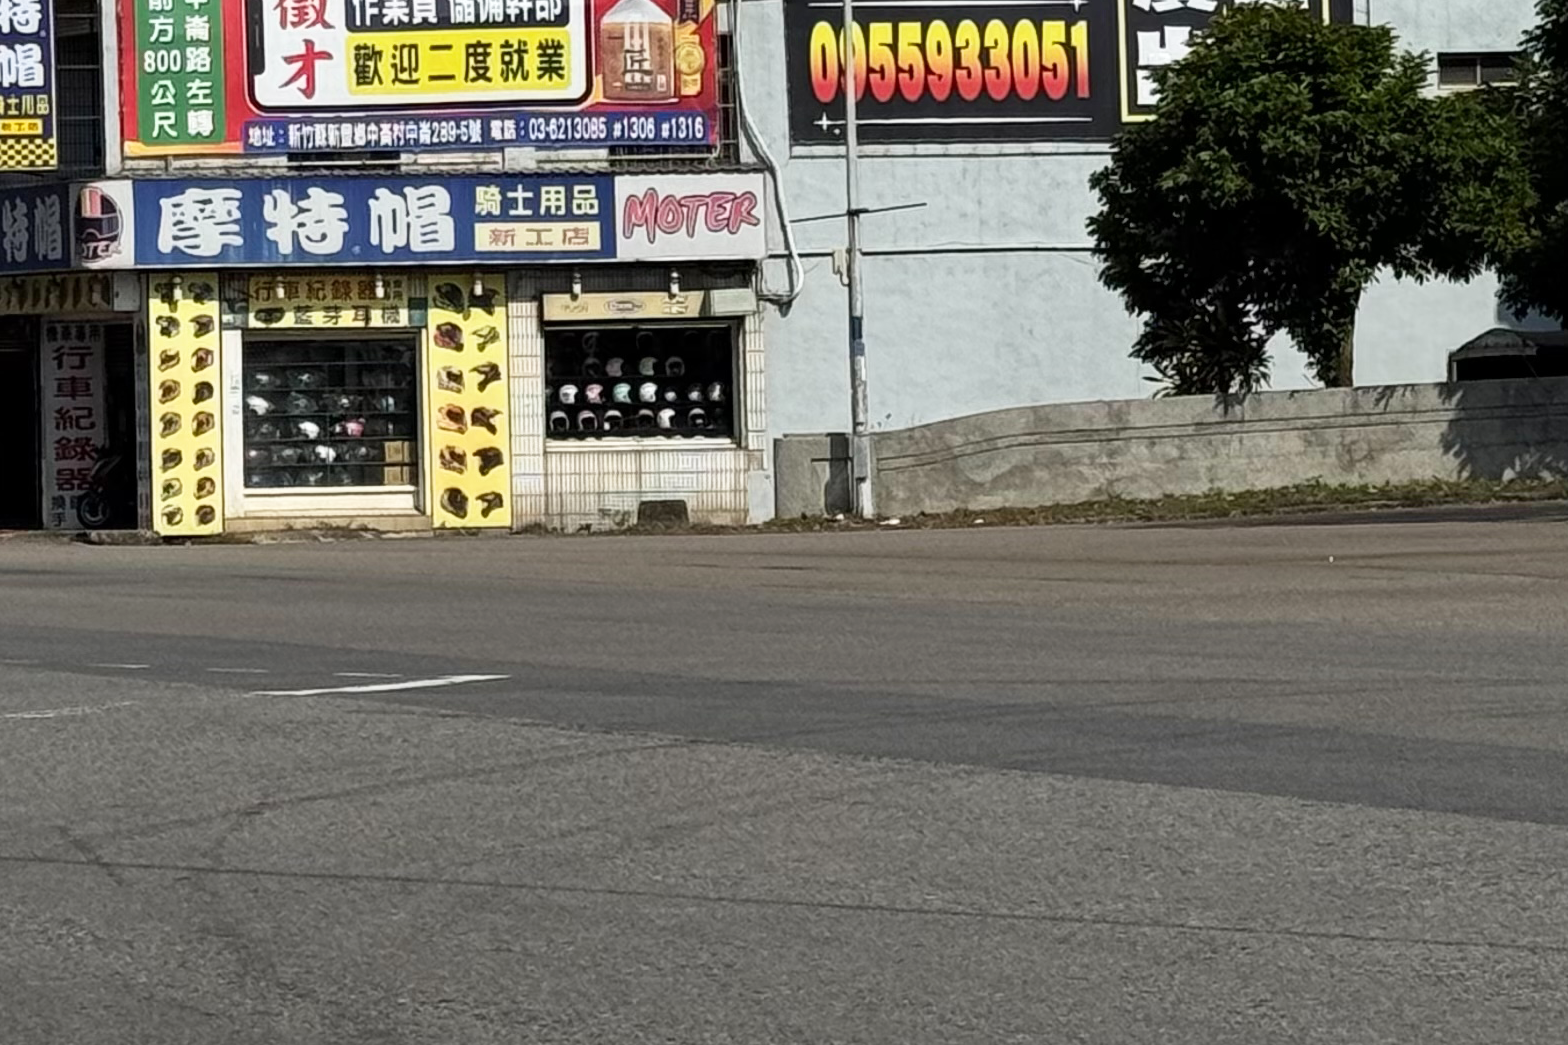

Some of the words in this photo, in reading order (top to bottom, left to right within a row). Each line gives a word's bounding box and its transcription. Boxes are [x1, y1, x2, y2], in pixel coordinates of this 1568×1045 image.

[352, 38, 567, 88] 歡迎二度就業
[809, 19, 1091, 103] 0955933051
[157, 185, 456, 255] 摩特帽
[475, 185, 600, 217] 騎士用品
[622, 187, 761, 244] MOTER
[52, 345, 97, 492] 行車紀錄器
